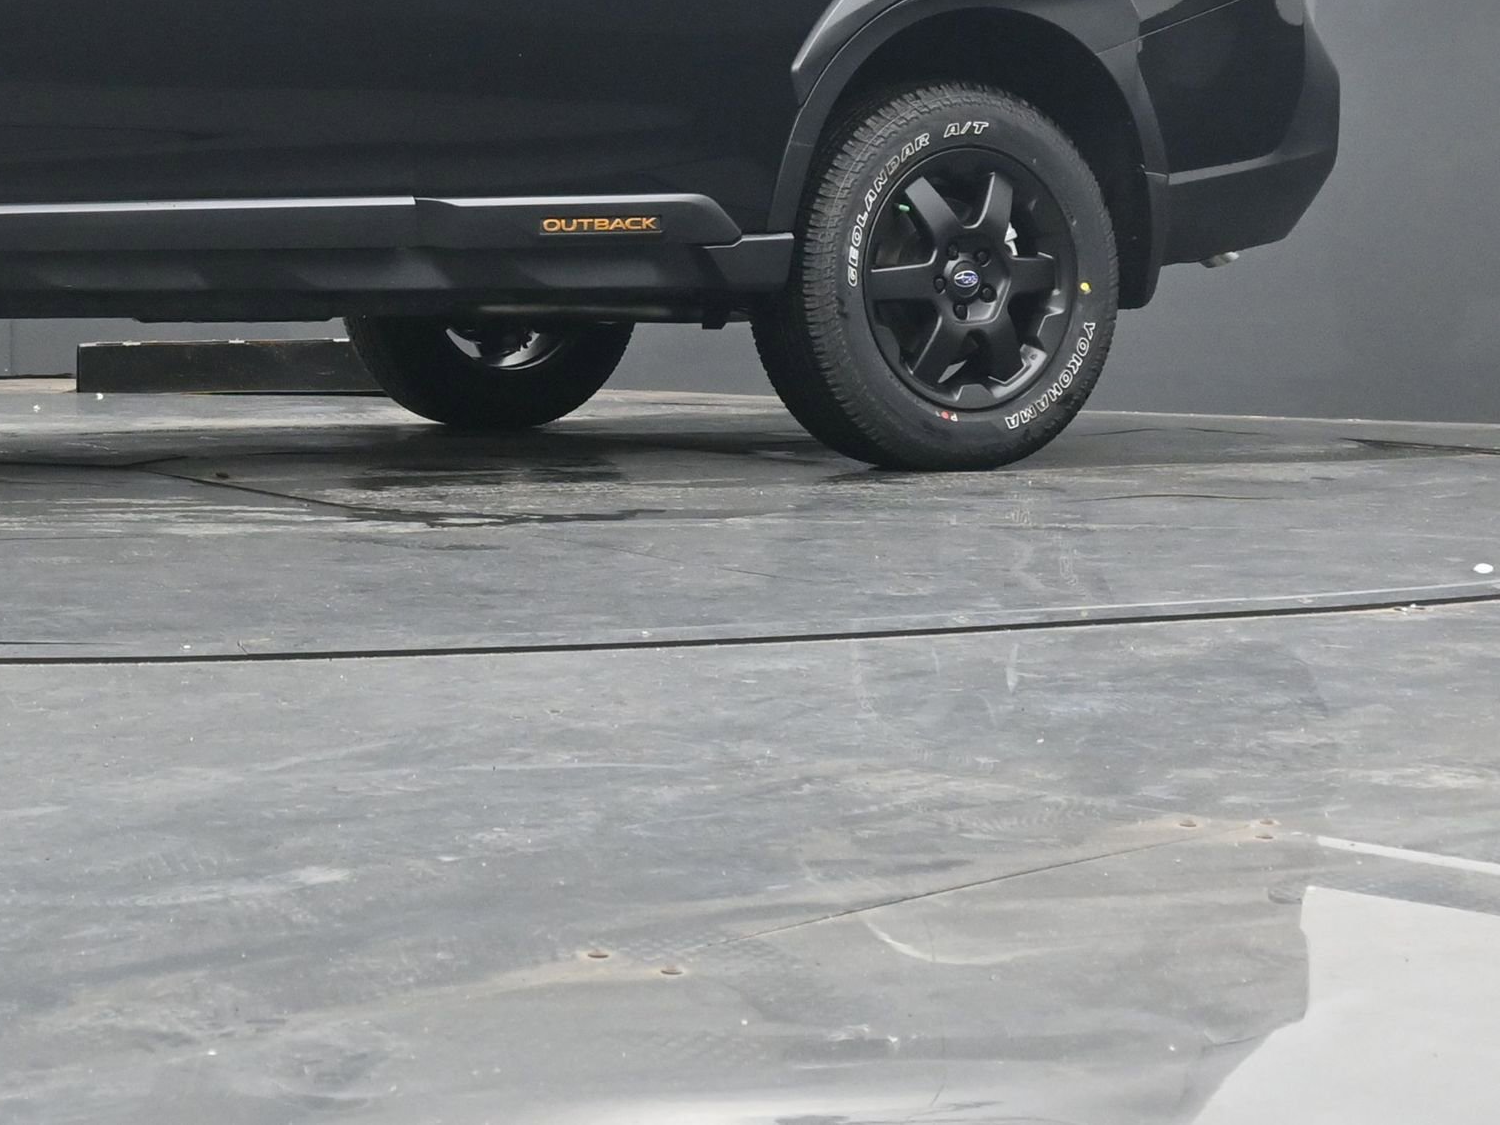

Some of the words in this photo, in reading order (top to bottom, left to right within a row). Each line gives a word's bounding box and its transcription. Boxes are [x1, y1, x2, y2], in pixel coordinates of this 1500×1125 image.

[542, 217, 657, 232] OUTBACK
[847, 132, 930, 287] GEOLANDAR
[943, 121, 989, 139] A/T
[1005, 322, 1096, 431] YOKOHAMA
